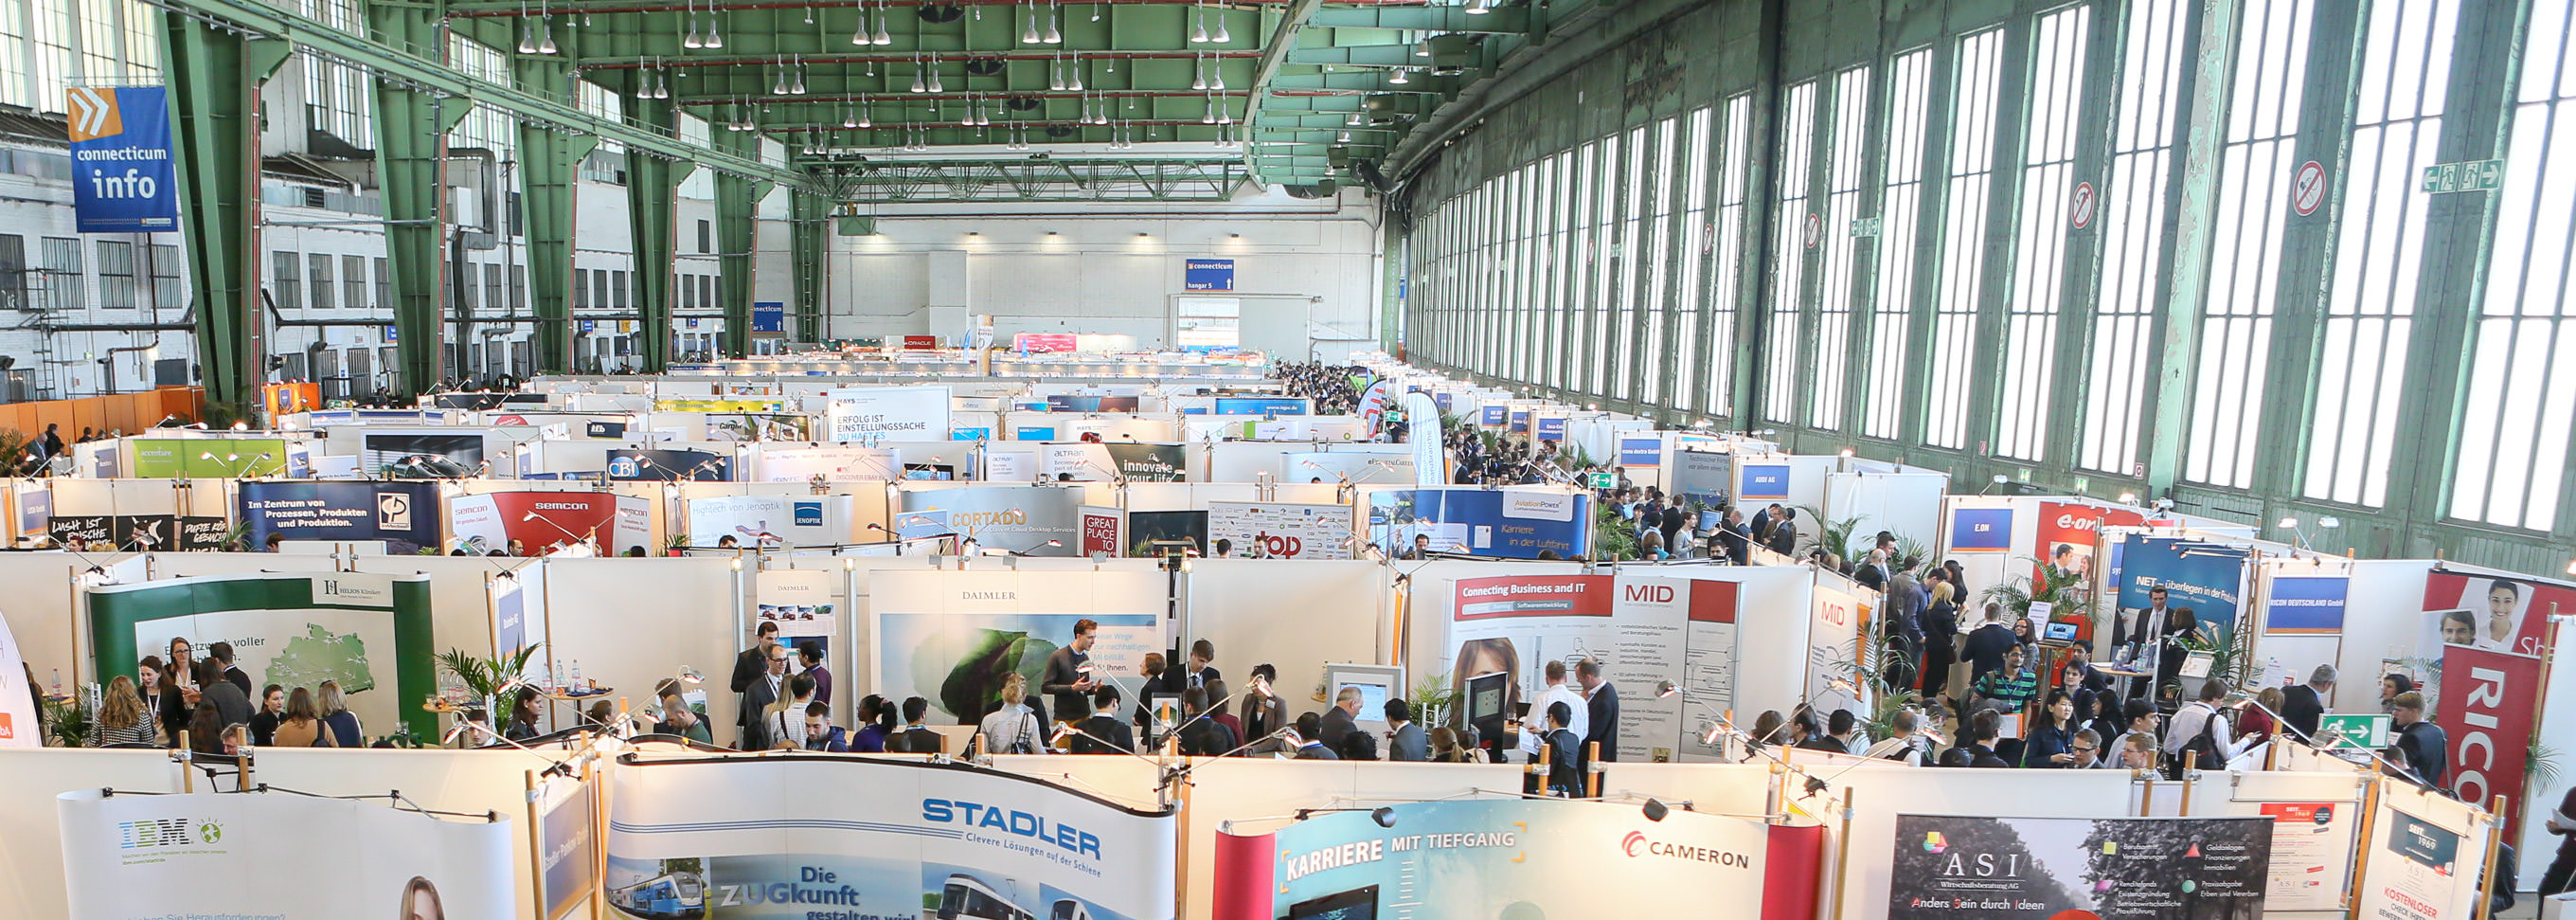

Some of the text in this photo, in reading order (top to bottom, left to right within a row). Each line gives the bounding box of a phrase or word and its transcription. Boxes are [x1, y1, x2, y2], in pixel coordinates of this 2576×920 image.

[77, 146, 167, 161] connecticum
[93, 169, 155, 199] info
[837, 414, 885, 424] ERFOLG IST
[837, 422, 926, 433] EINSTELLUNGSSACHE
[837, 433, 850, 442] DU
[1123, 459, 1173, 474] innovate
[1124, 474, 1152, 482] your
[248, 500, 262, 509] Im
[263, 500, 305, 509] Zentrum
[455, 505, 489, 516] semcon
[535, 502, 589, 511] semcon
[746, 501, 781, 513] Jenoptik
[265, 509, 367, 519] Prozessen, Produkten
[952, 511, 1028, 527] CORTADO
[52, 516, 103, 533] LUSH IST
[277, 519, 352, 528] und Produktion.
[1086, 517, 1116, 530] GREAT
[1501, 523, 1534, 534] Karriere
[1975, 523, 1990, 532] E.ON
[1086, 528, 1115, 540] PLACE
[1101, 539, 1114, 551] TO
[1509, 537, 1569, 550] in der Luftfahrt
[1462, 583, 1586, 598] Connecting Business and IT
[2136, 575, 2157, 587] NET
[2165, 579, 2204, 595] überlegen
[2204, 586, 2210, 597] in
[2210, 586, 2221, 599] der
[961, 590, 1016, 601] DAIMLER
[1624, 584, 1674, 603] MID
[2287, 599, 2327, 607] DEUTSCHLAND
[2327, 599, 2344, 607] GmbH
[1821, 600, 1846, 626] MID
[233, 637, 265, 648] voller
[1114, 632, 1134, 641] Wege
[1106, 642, 1151, 653] nachhaltigen
[118, 818, 189, 849] IBM
[921, 798, 1101, 861] STADLER
[2407, 822, 2424, 836] SEIT
[2206, 843, 2245, 853] Geldanlagen
[2418, 837, 2438, 850] 1969
[966, 832, 1101, 878] Clevere Lösungen auf der Schiene
[1285, 831, 1515, 882] KARRIERE MIT TIEFGANG
[1649, 841, 1749, 869] CAMERON
[2122, 853, 2168, 862] Versicherungen
[2205, 854, 2251, 862] Finanzierungen
[800, 866, 837, 883] Die
[1941, 881, 2007, 891] Wirtschaftsberatung
[2201, 880, 2243, 889] Praxisabgabe
[720, 882, 860, 907] ZUGkunft
[2118, 890, 2171, 899] Existenzgründung
[1911, 896, 2045, 911] Anders Sein durch Ideen
[2117, 899, 2182, 908] Betriebswirtschaftliche
[2384, 886, 2439, 919] KOSTENLOSER
[2390, 903, 2409, 917] CHECK
